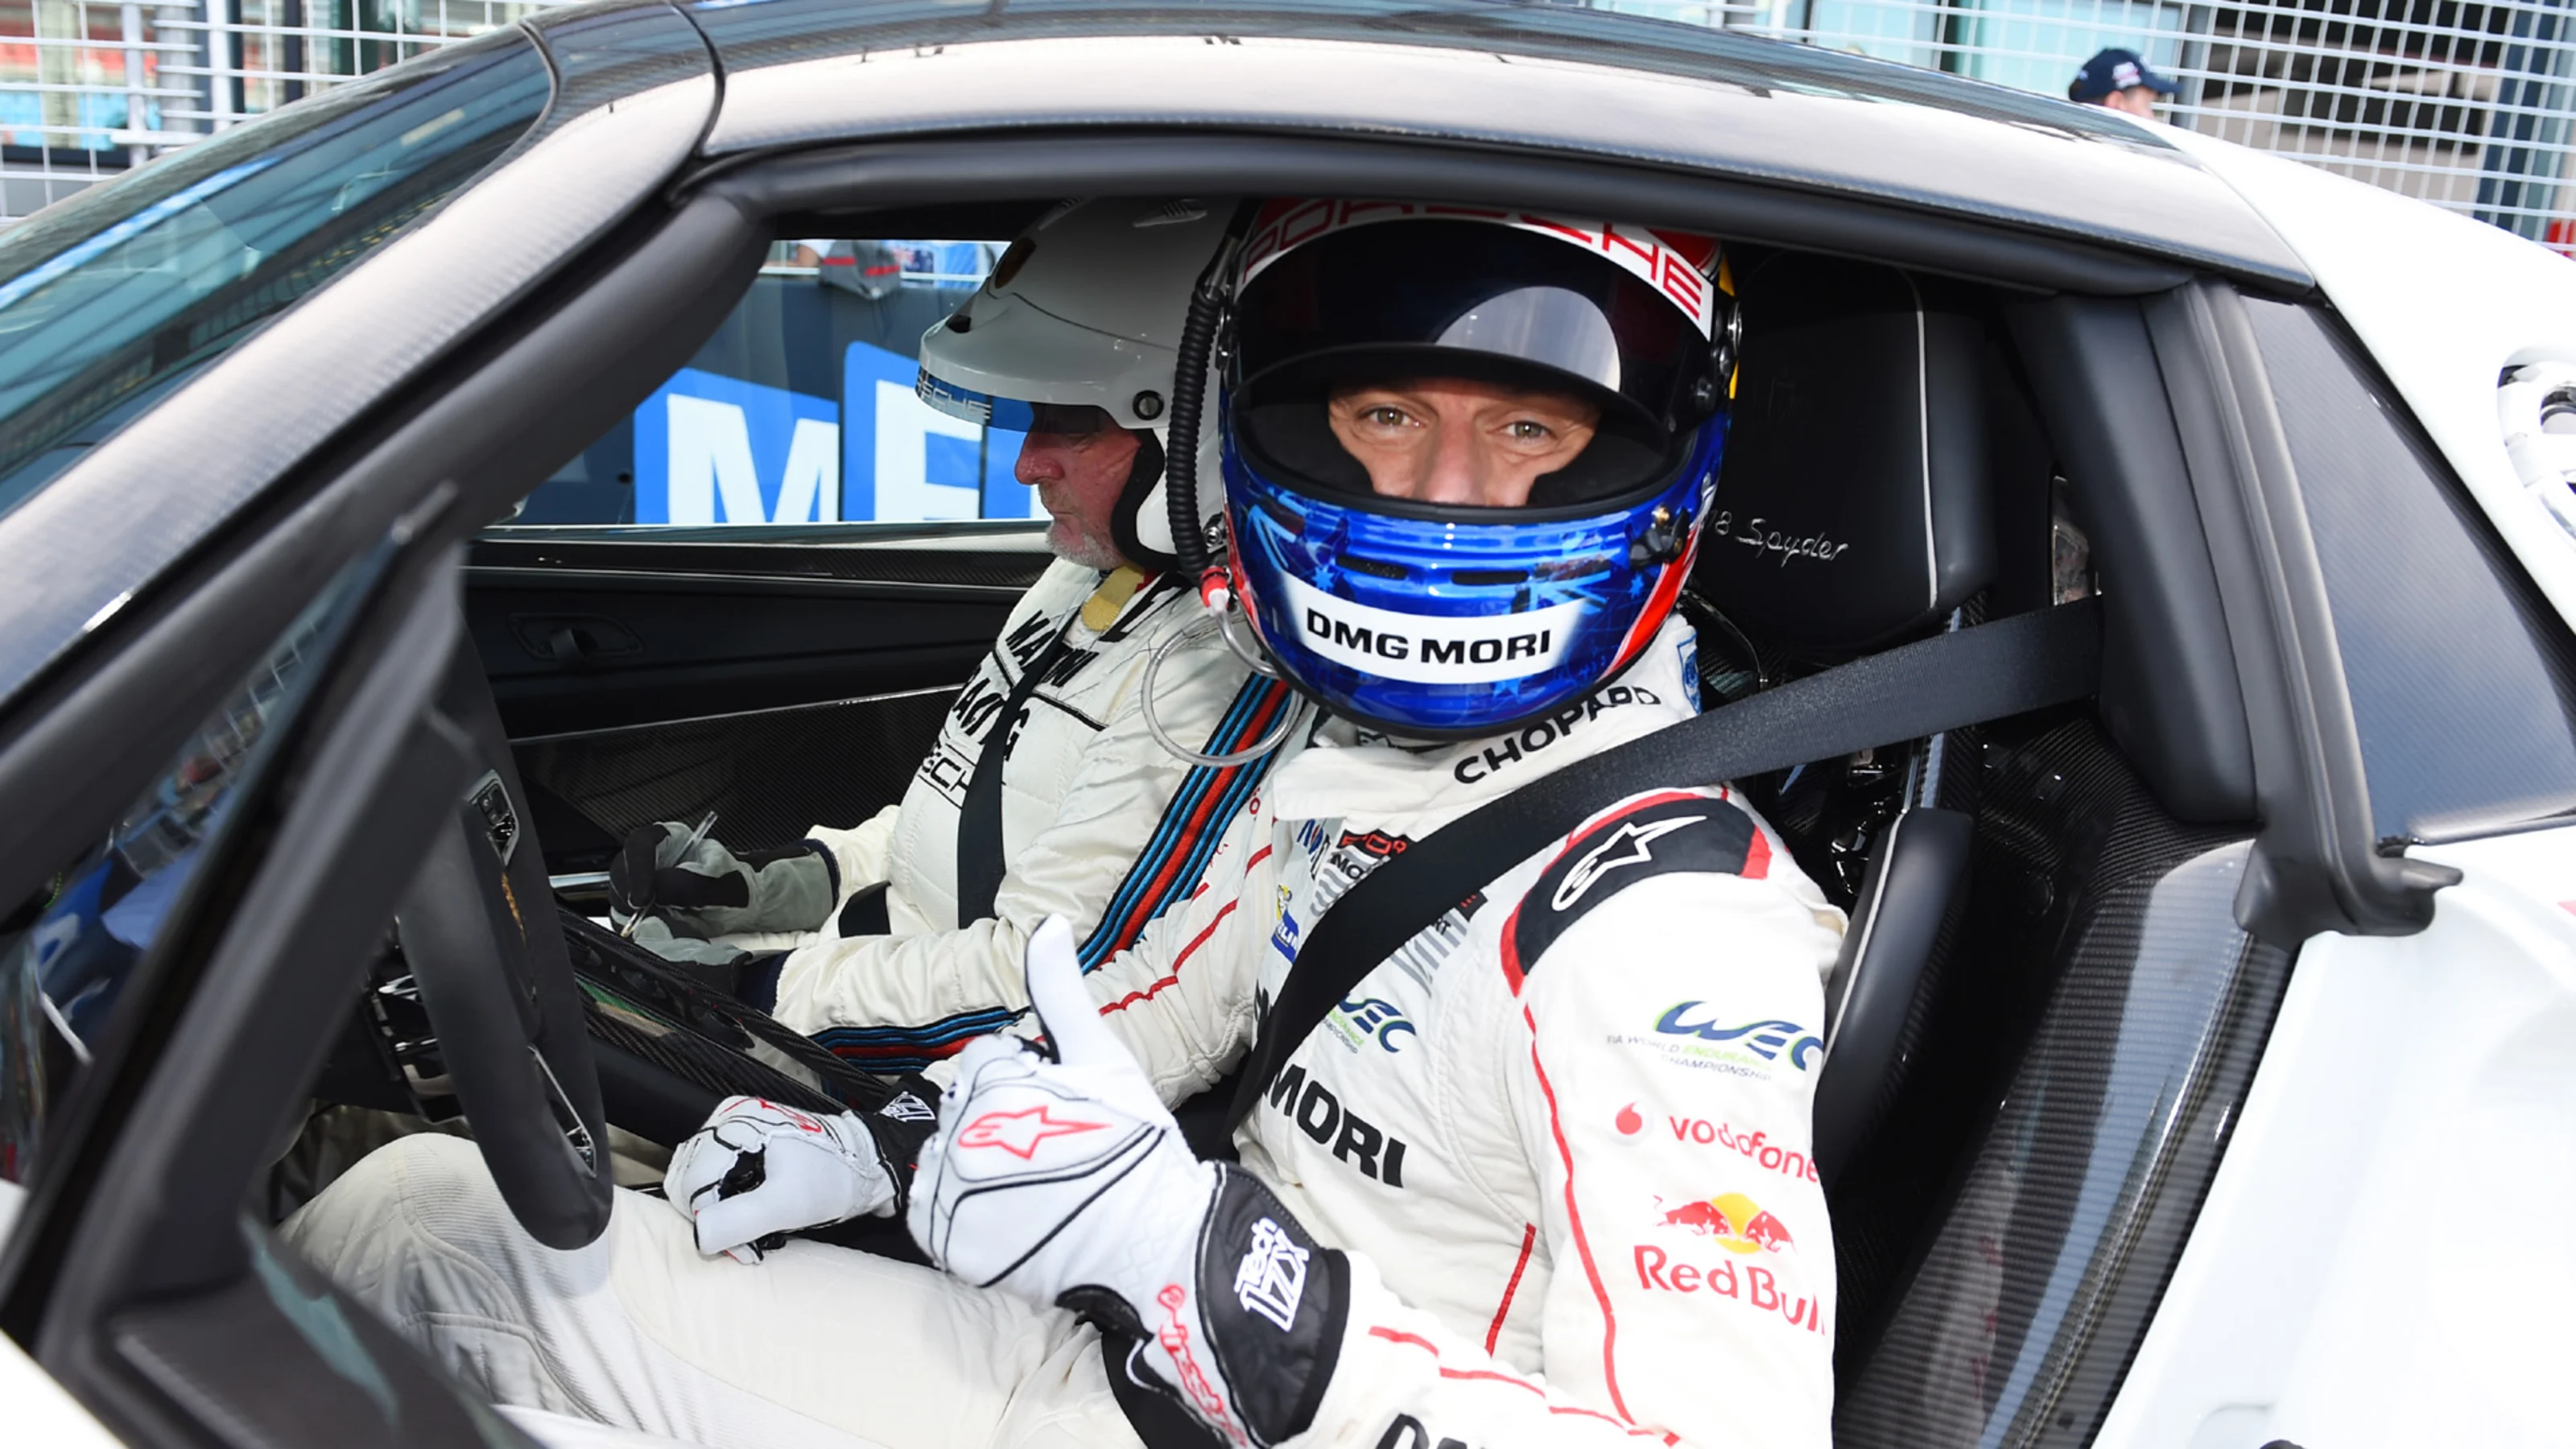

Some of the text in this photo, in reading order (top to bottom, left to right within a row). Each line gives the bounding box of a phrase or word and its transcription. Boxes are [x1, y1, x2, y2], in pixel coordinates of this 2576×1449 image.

[1736, 518, 1848, 568] Spyder
[1306, 608, 1550, 665] DMG MORI
[1264, 1063, 1407, 1189] MORI
[1669, 1116, 1819, 1183] vodafone
[1233, 1216, 1278, 1294] Tech
[1633, 1245, 1826, 1336] Red Bul
